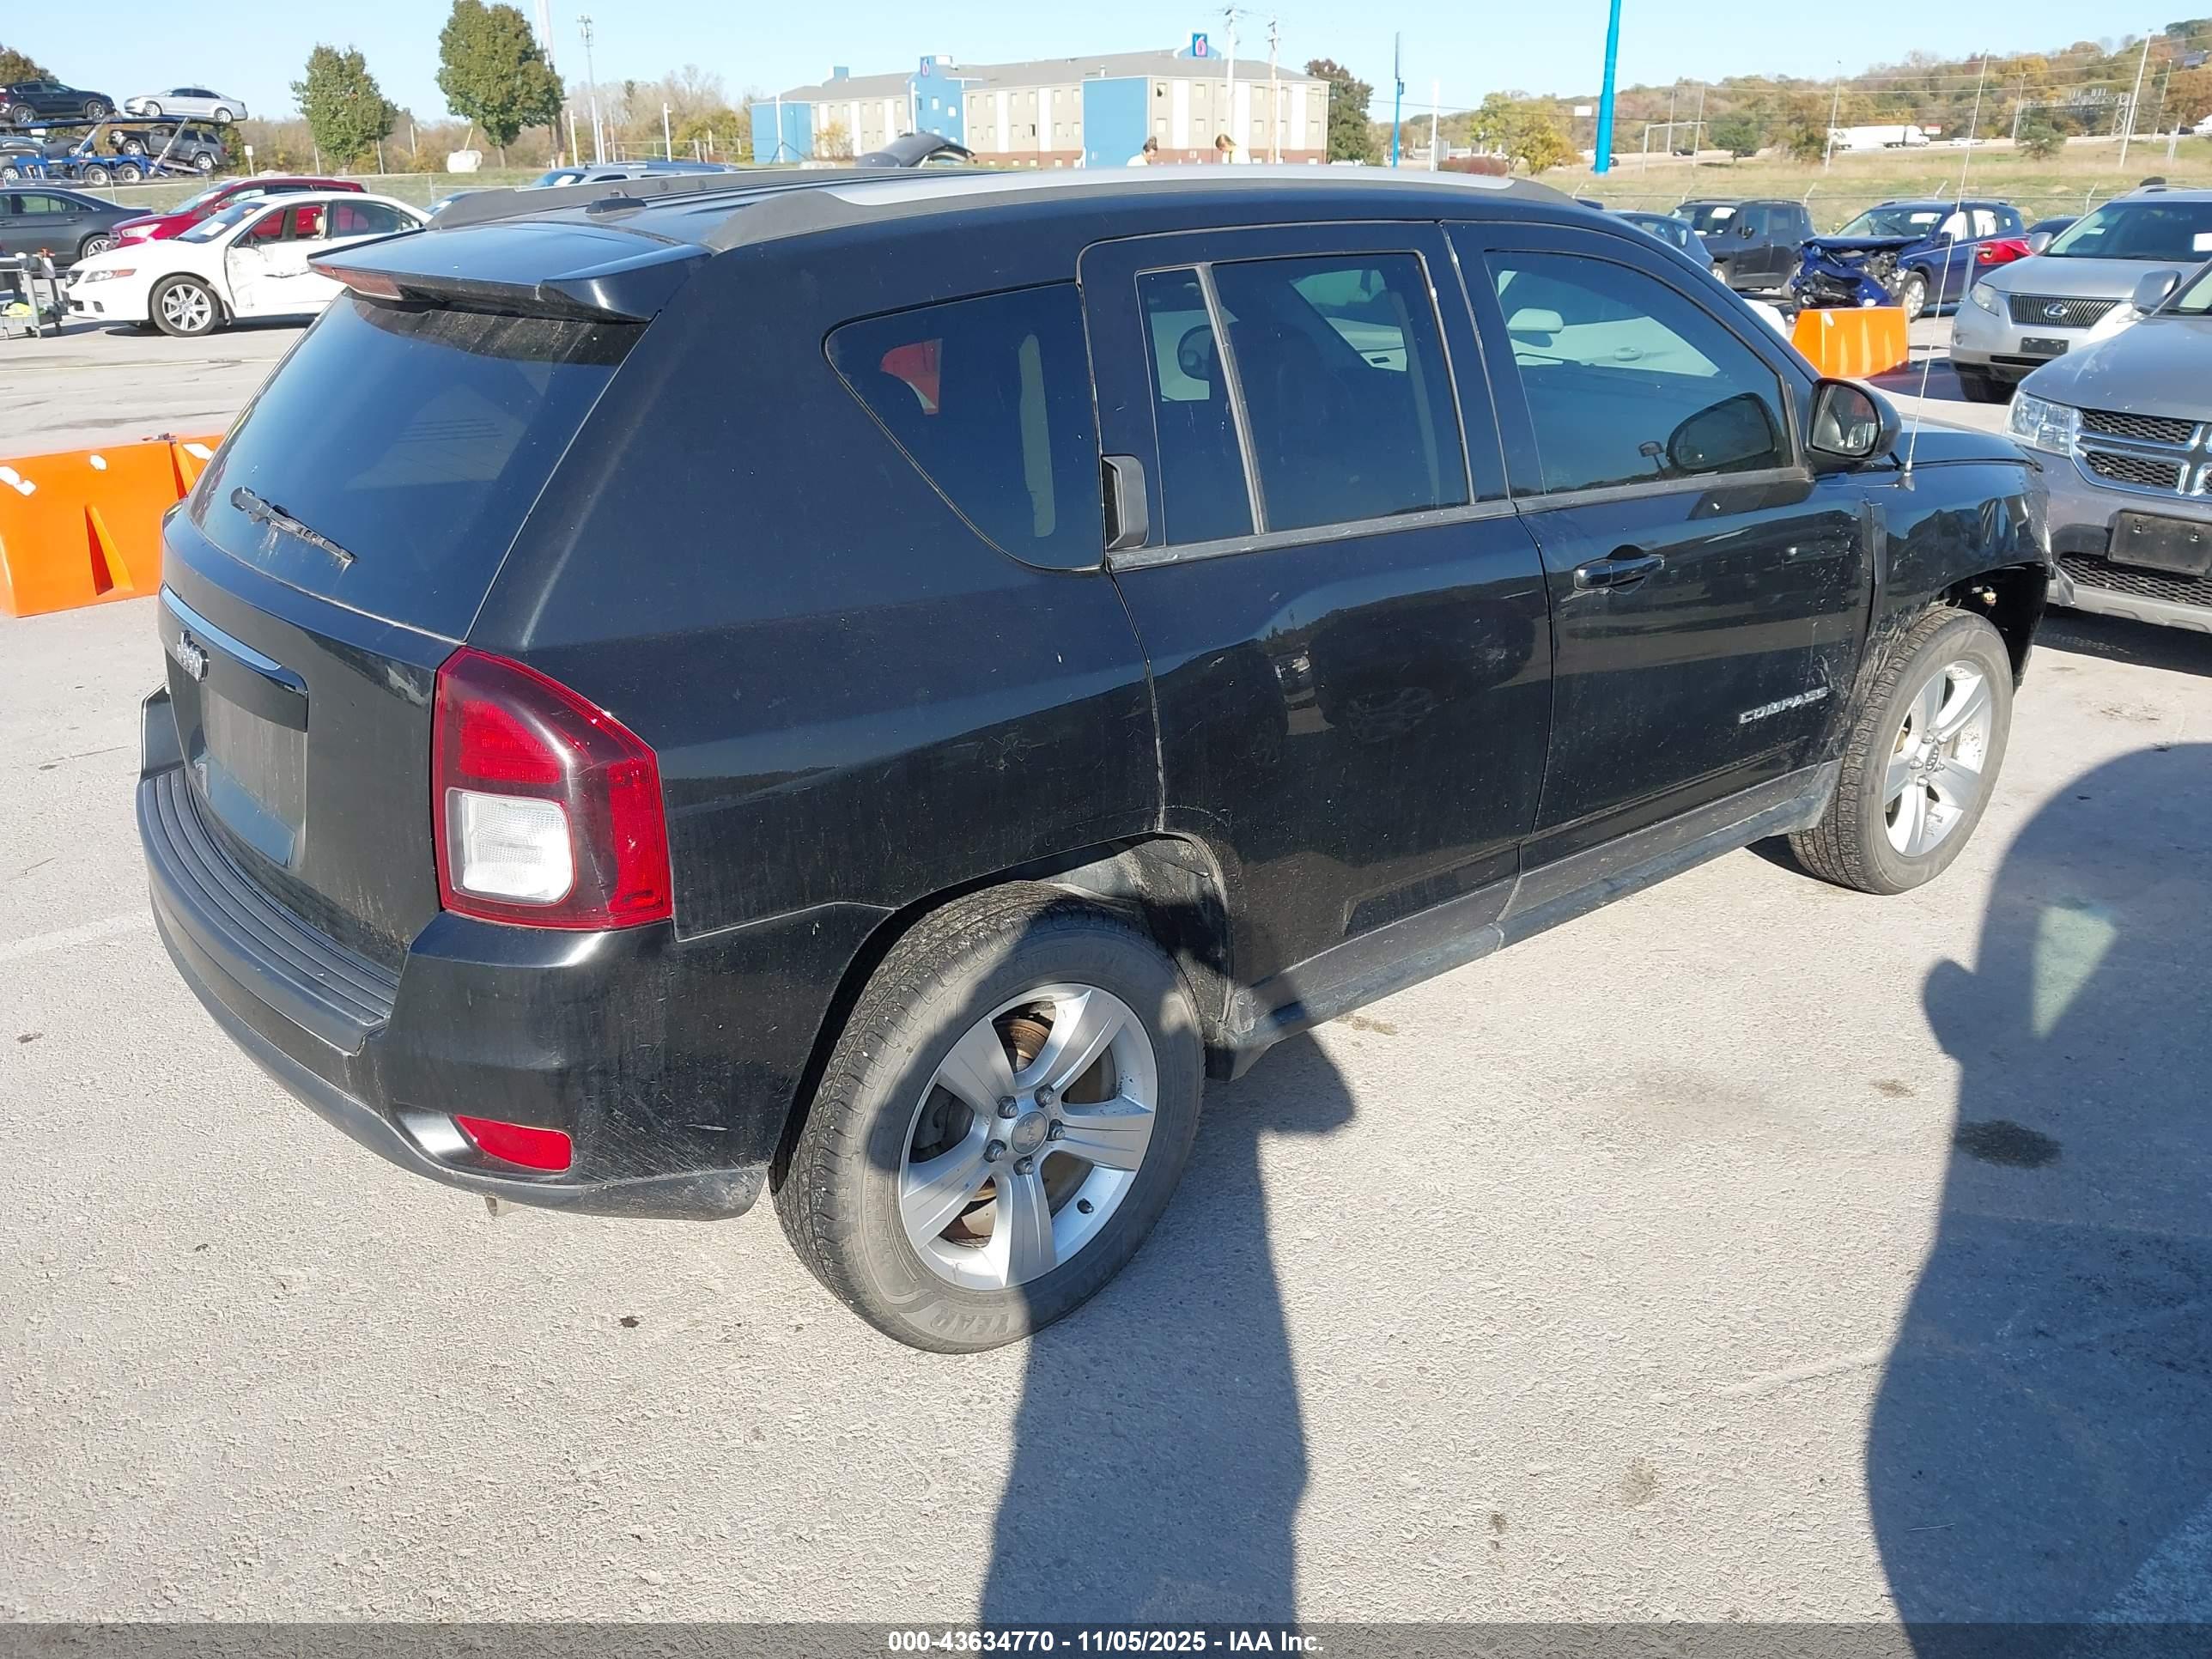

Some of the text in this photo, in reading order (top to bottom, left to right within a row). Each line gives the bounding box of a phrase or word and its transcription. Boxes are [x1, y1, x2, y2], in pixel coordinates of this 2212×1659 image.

[1195, 35, 1206, 56] 6
[922, 58, 930, 76] 6
[1739, 686, 1829, 724] COMPASS
